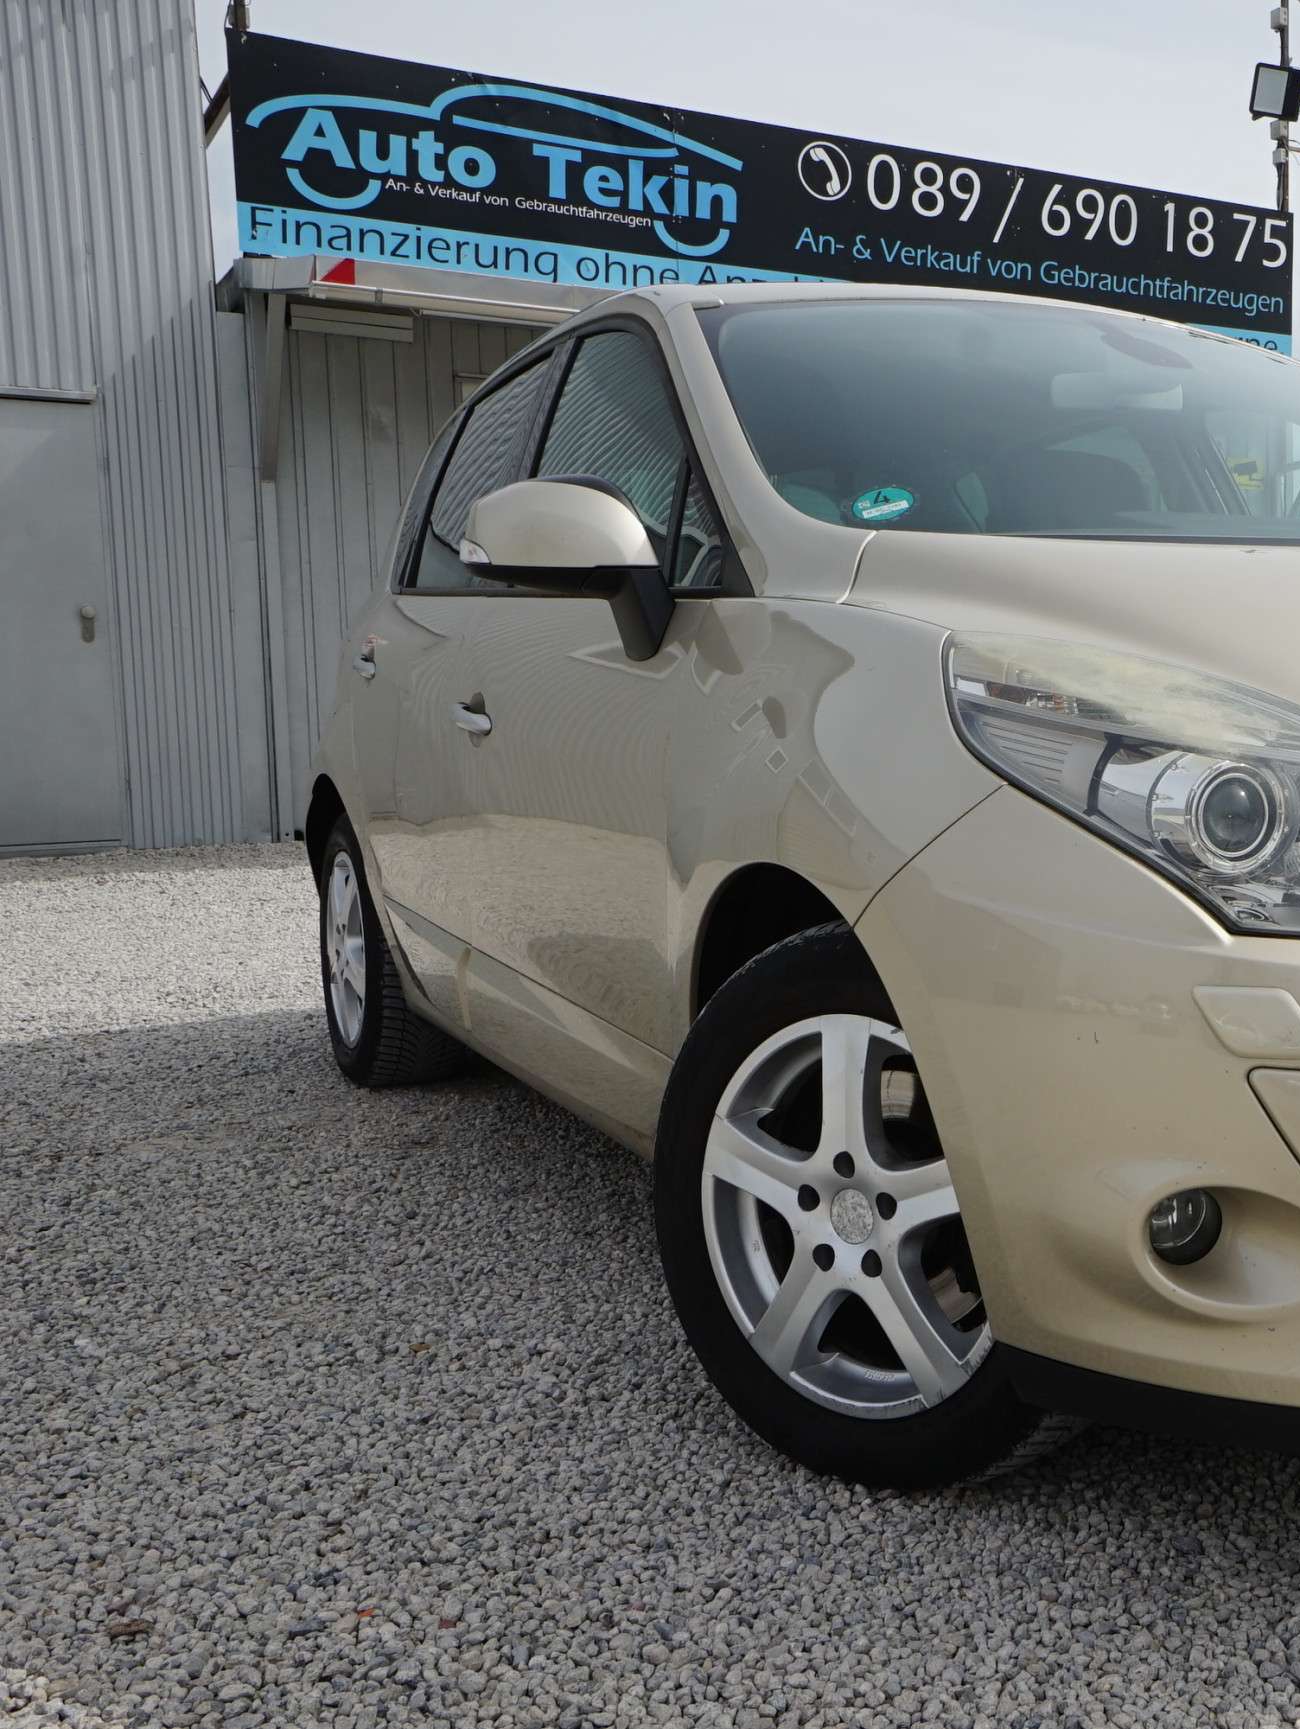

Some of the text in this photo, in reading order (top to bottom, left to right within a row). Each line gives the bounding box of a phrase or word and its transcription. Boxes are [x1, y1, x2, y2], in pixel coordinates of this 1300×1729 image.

[281, 108, 738, 224] Auto Tekin
[386, 178, 652, 228] An- & Verkauf von Gebrauchtfahrzeugen
[867, 153, 1288, 269] 089 / 690 18 75
[250, 206, 680, 284] Finanzierung ohne
[795, 227, 1284, 317] An- & Verkauf von Gebrauchtfahrzeugen
